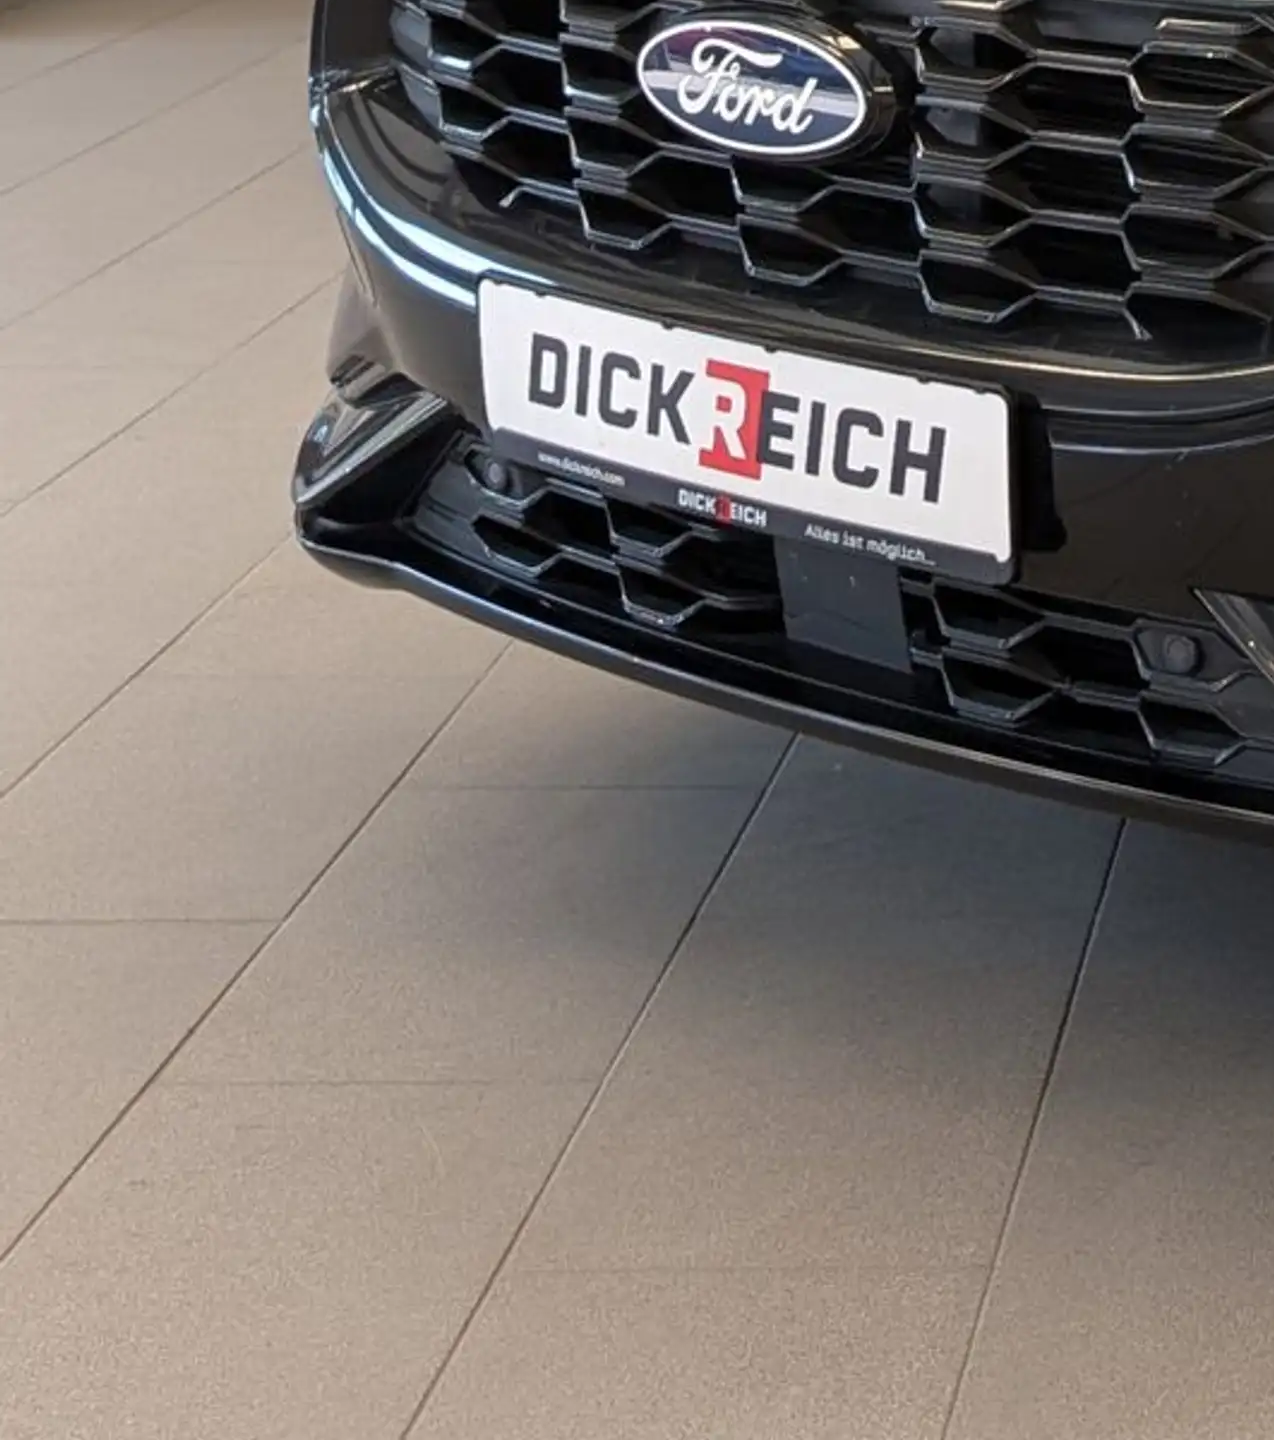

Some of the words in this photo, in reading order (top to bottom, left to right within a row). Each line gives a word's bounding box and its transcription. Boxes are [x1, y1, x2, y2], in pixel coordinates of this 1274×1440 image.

[677, 37, 819, 135] Ford
[528, 333, 947, 503] DICKREICH
[677, 487, 768, 528] DICKREICH
[804, 522, 840, 545] Alles
[842, 530, 865, 551] ist
